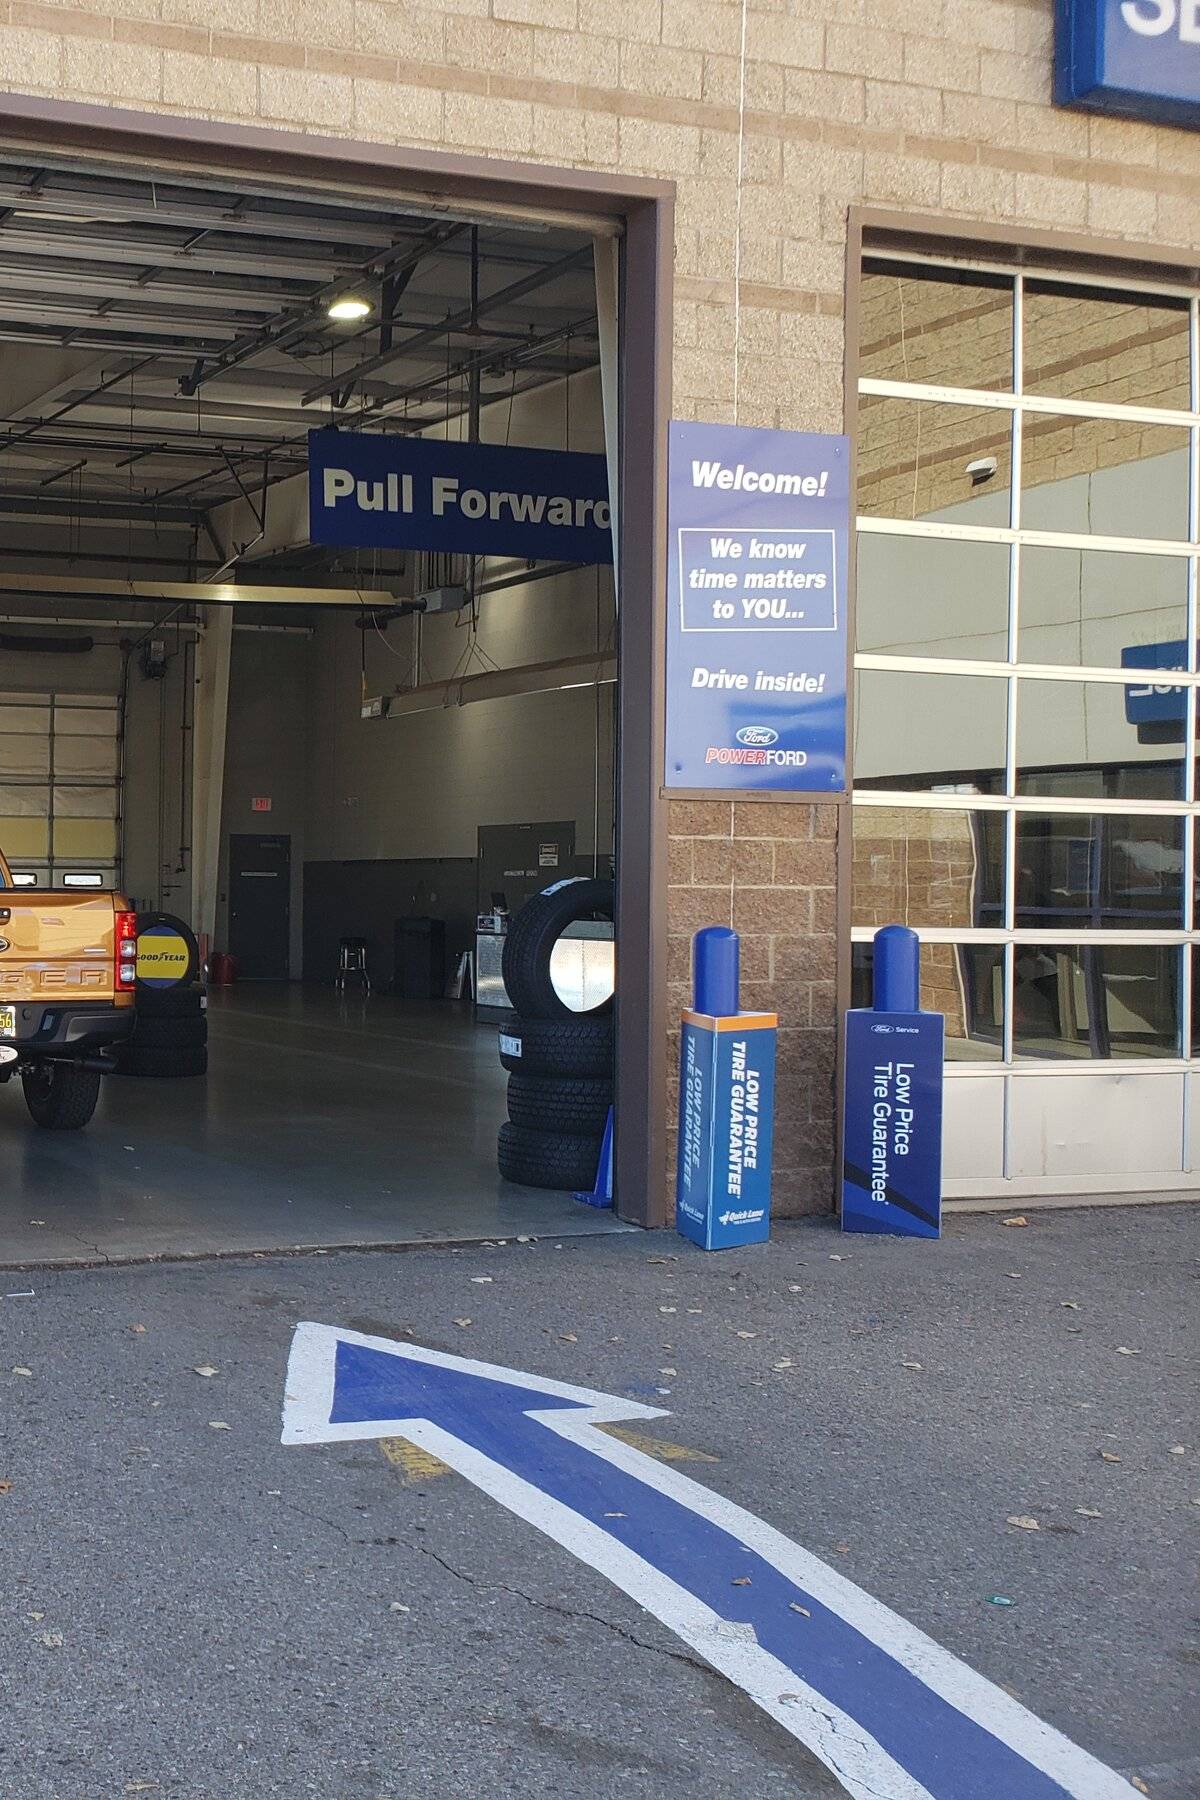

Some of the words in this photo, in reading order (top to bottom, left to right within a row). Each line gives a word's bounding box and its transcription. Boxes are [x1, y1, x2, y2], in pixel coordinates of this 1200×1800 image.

[323, 467, 413, 513] Pull
[692, 460, 828, 497] Welcome!
[710, 538, 742, 559] We
[749, 539, 806, 559] know
[688, 570, 737, 589] time
[743, 571, 827, 589] matters
[712, 600, 734, 619] to
[742, 599, 804, 619] YOU...
[691, 668, 748, 689] Drive
[754, 670, 825, 693] inside!
[687, 1035, 696, 1077] TIRE
[731, 1041, 746, 1082] TIRE
[693, 1066, 703, 1111] LOW
[745, 1069, 760, 1112] LOW
[873, 1062, 892, 1098] Tire
[896, 1063, 914, 1104] Low
[692, 1110, 701, 1169] PRICE
[743, 1115, 758, 1169] PRICE
[895, 1107, 913, 1155] Price
